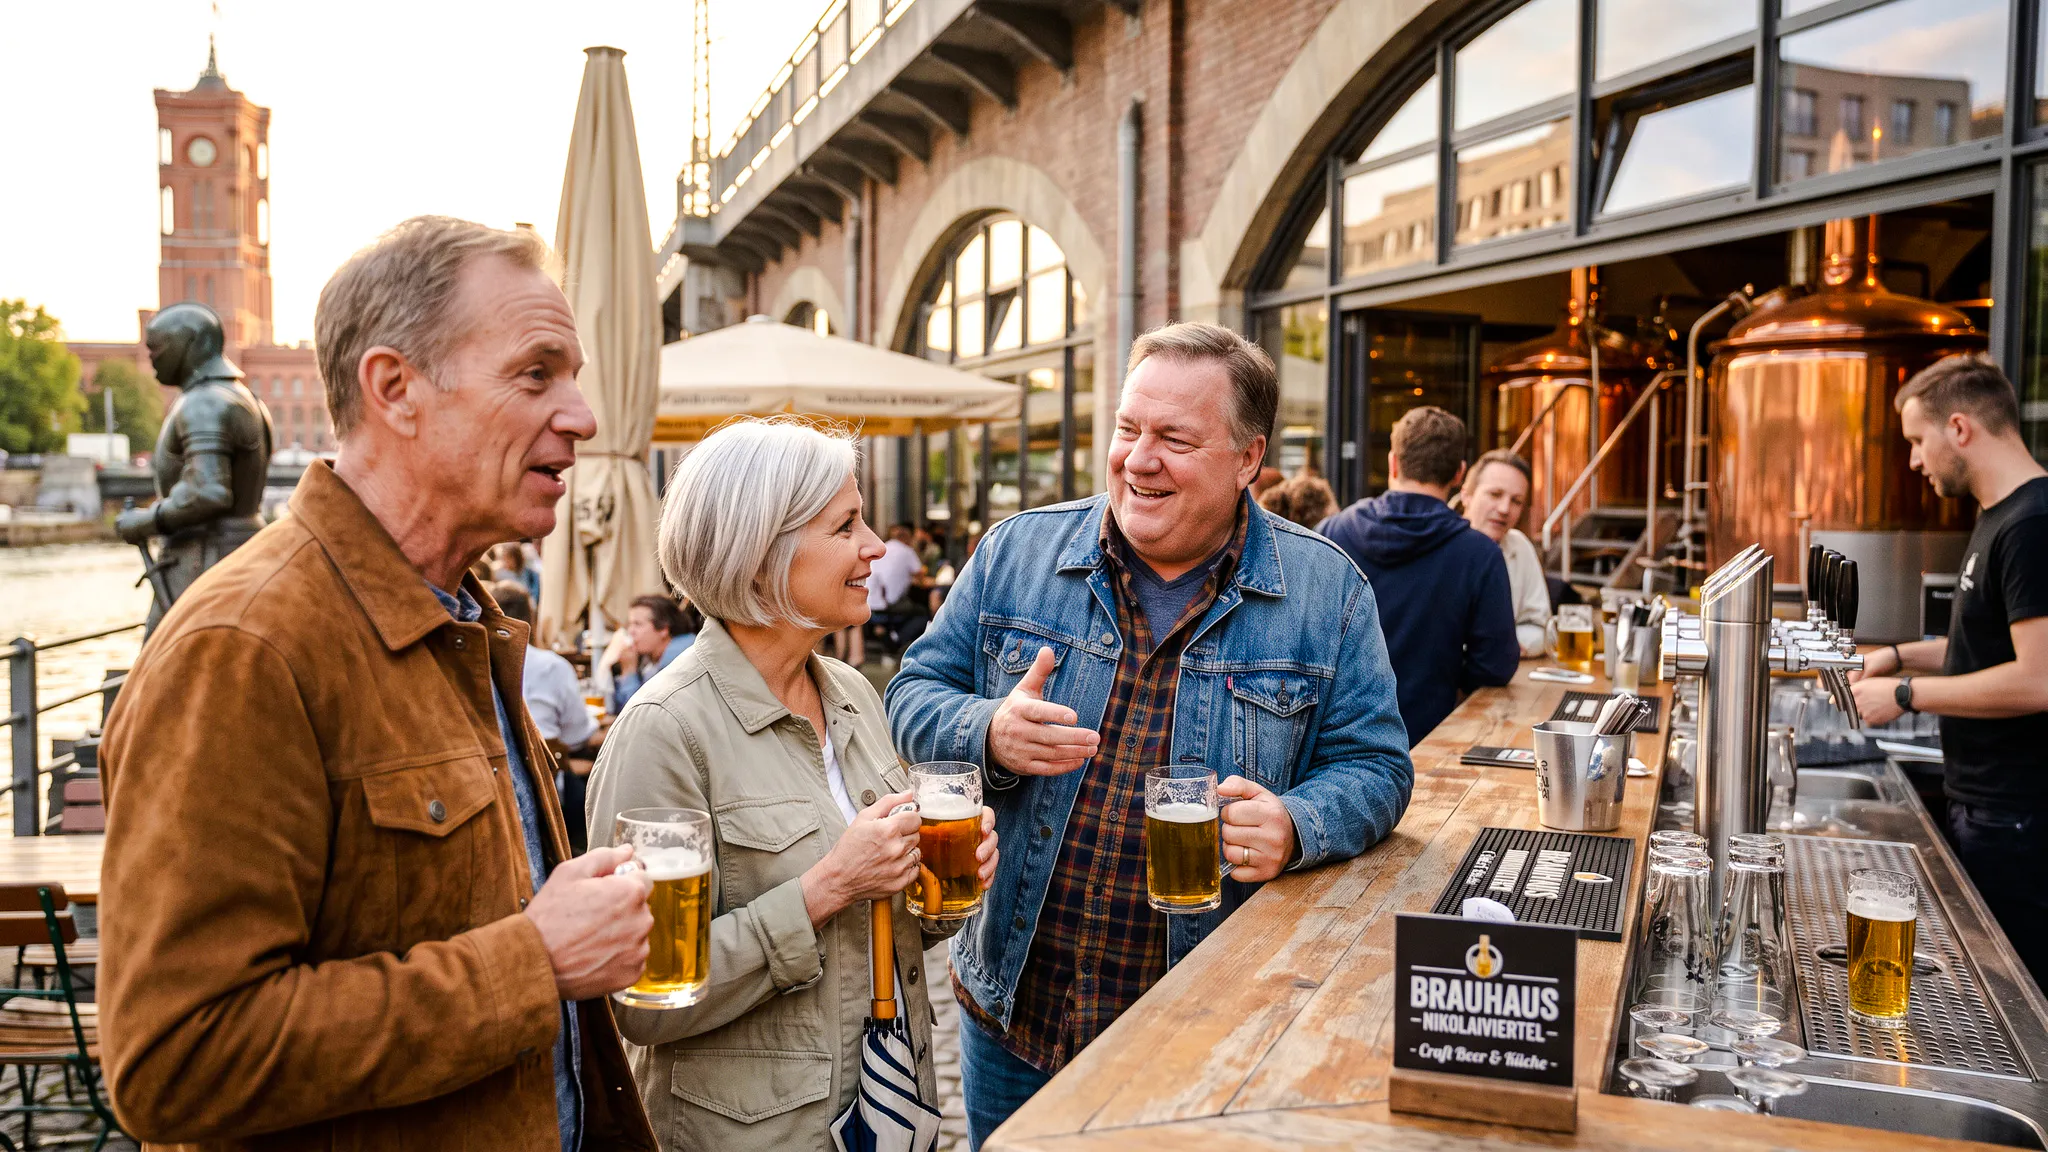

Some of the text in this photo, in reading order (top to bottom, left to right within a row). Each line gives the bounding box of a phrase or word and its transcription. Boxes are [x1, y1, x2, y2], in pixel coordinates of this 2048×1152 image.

[1410, 975, 1559, 1021] BRAUHAUS
[1422, 1012, 1546, 1043] NIKOLAIVIERTEL
[1418, 1042, 1453, 1064] Craft
[1454, 1046, 1488, 1064] Beer
[1488, 1050, 1502, 1066] &
